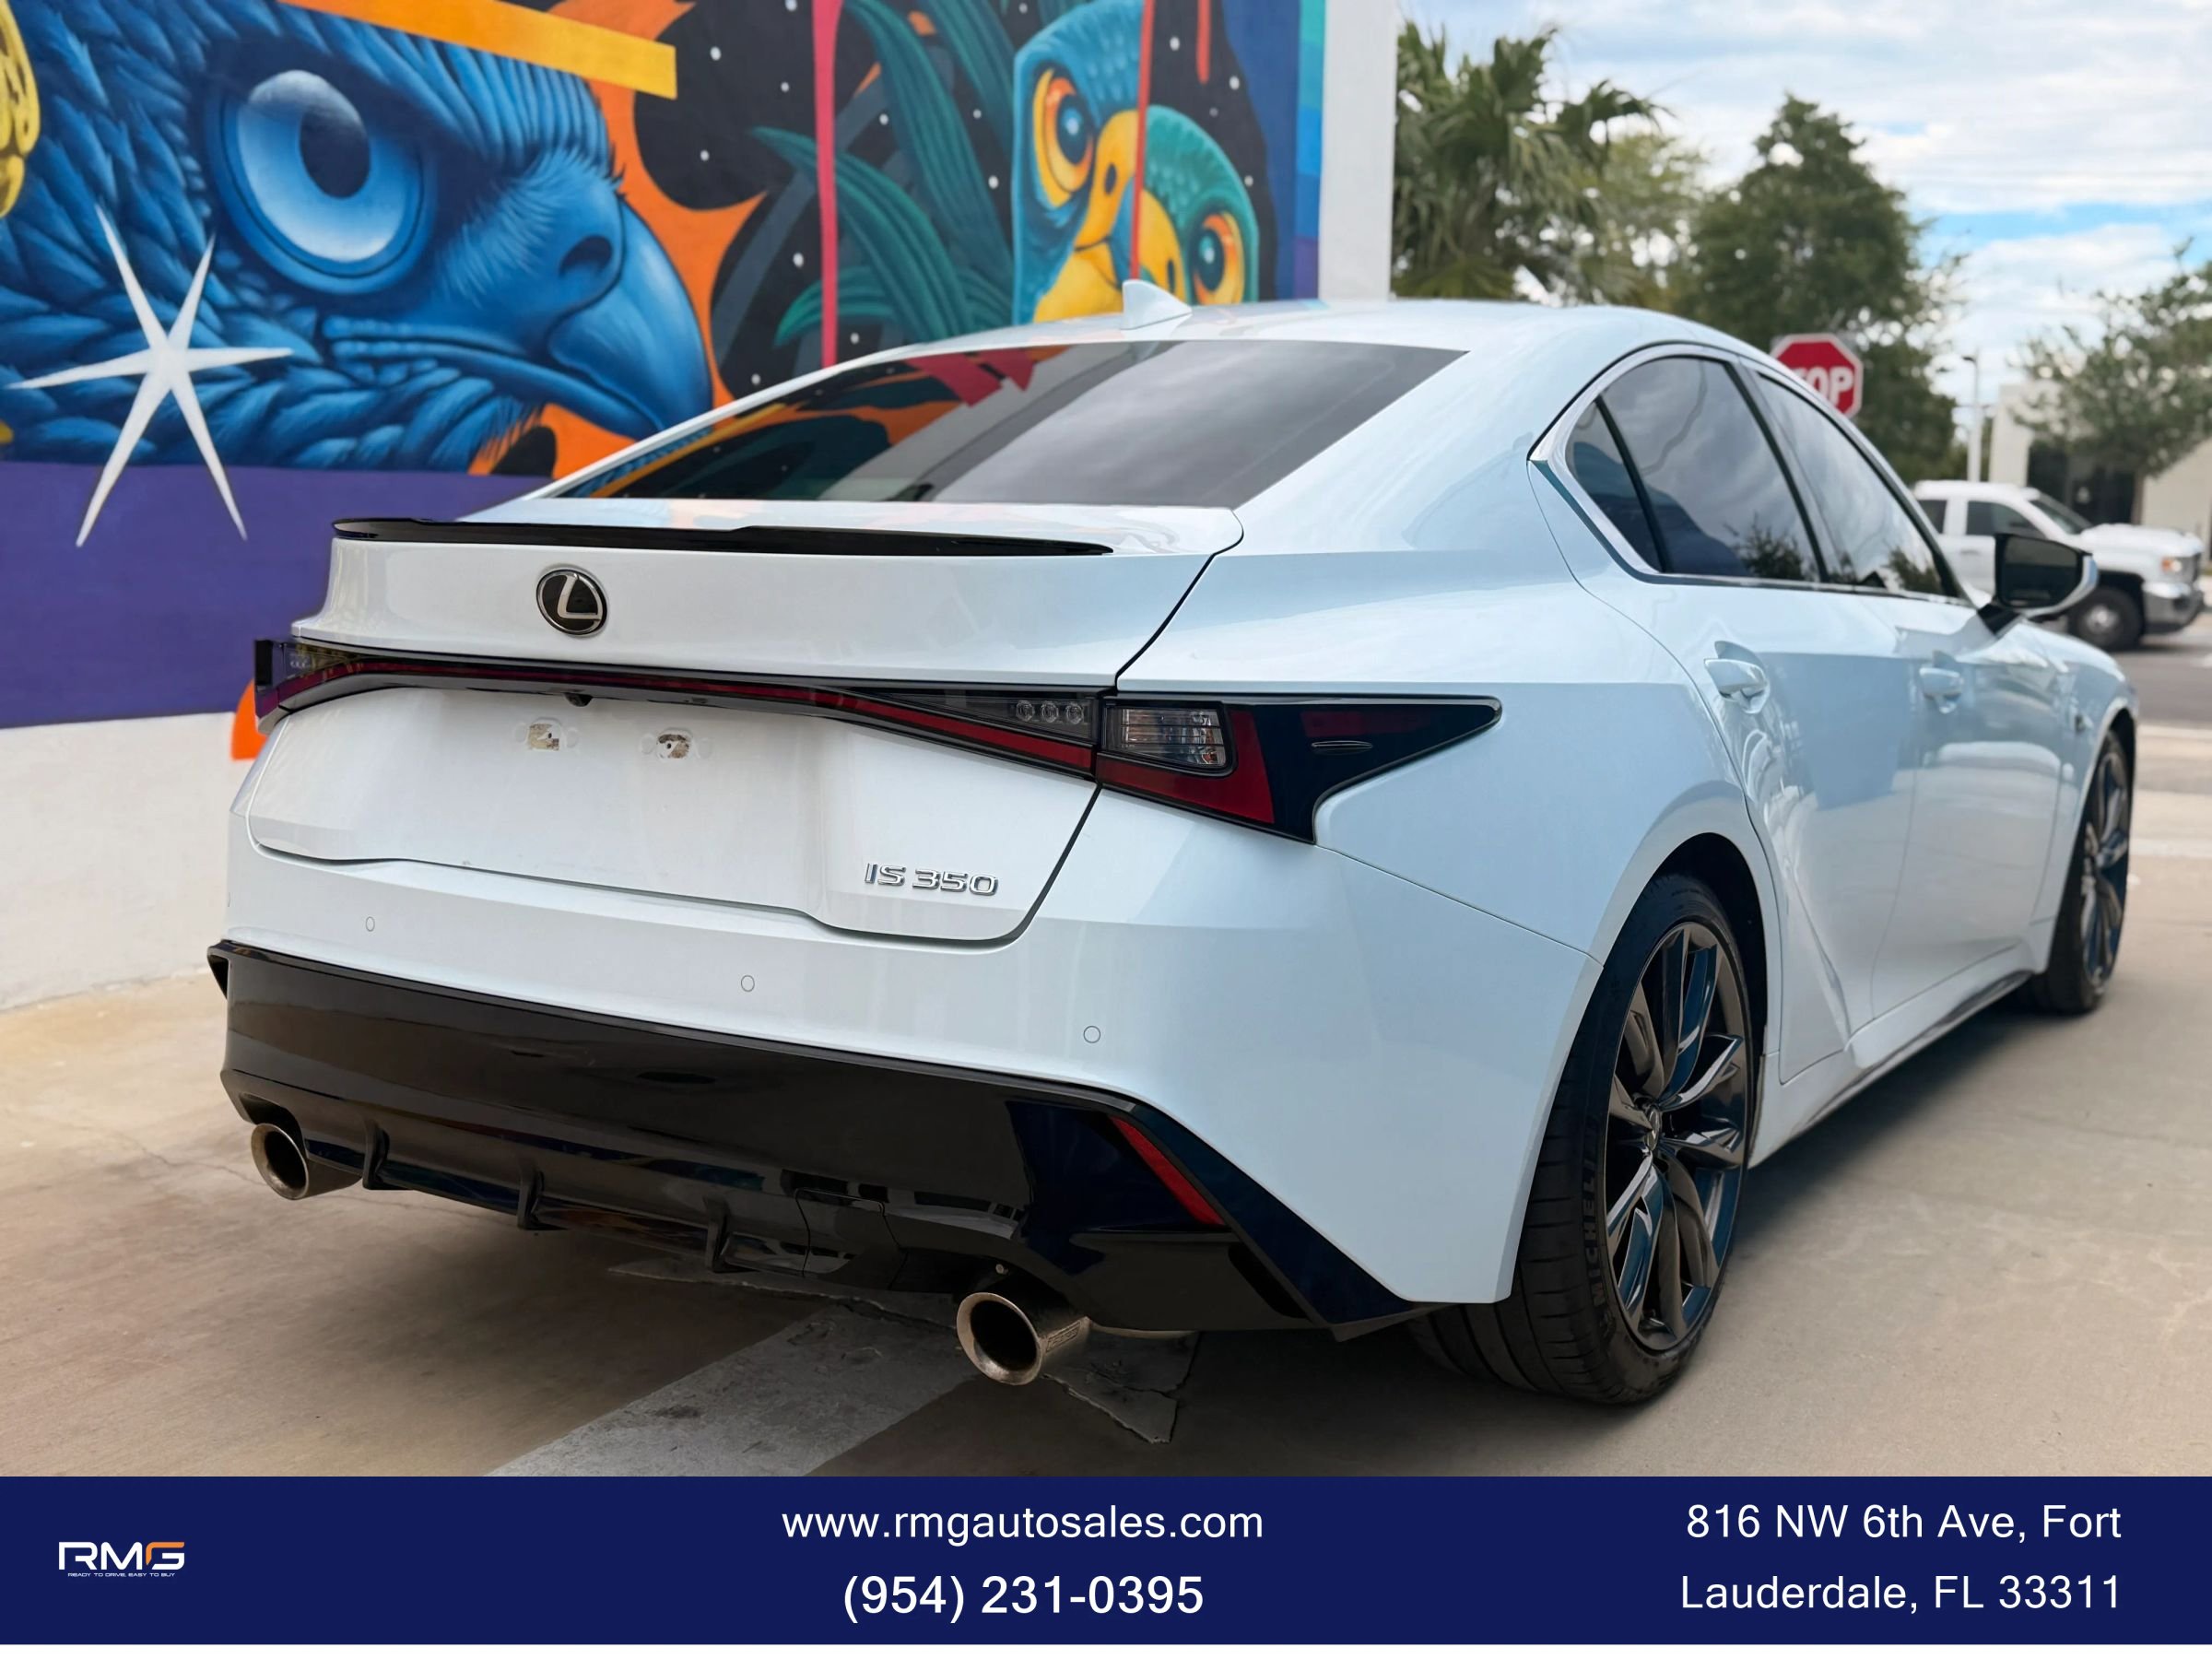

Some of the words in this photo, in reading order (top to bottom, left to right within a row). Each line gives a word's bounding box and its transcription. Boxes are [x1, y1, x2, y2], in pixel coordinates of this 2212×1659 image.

[1791, 366, 1853, 407] OP
[865, 863, 906, 887] IS
[912, 868, 999, 896] 350
